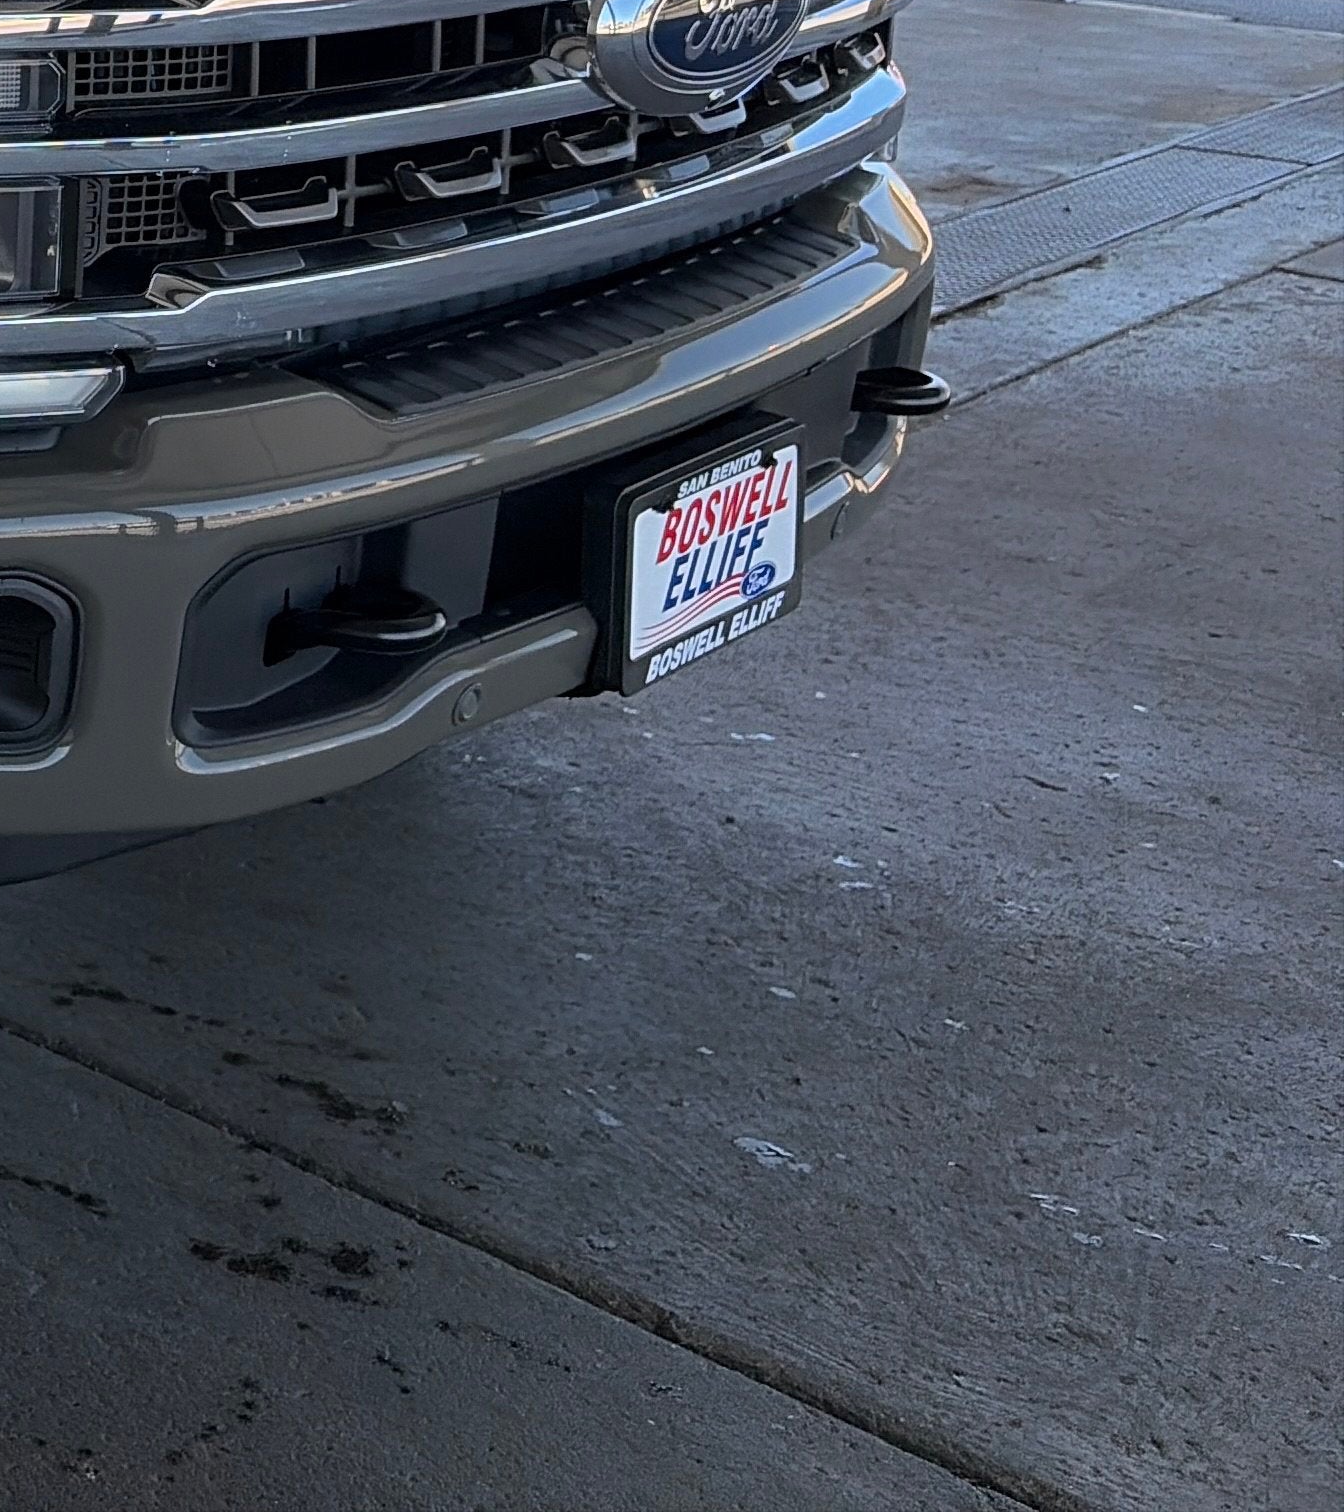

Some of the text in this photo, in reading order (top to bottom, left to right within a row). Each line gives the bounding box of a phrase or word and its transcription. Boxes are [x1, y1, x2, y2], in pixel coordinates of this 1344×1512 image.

[656, 460, 793, 565] BOSWELL
[677, 449, 762, 499] SAN BENITO
[662, 517, 770, 613] ELLIFF
[645, 590, 786, 685] BOSWELL ELLIFF
